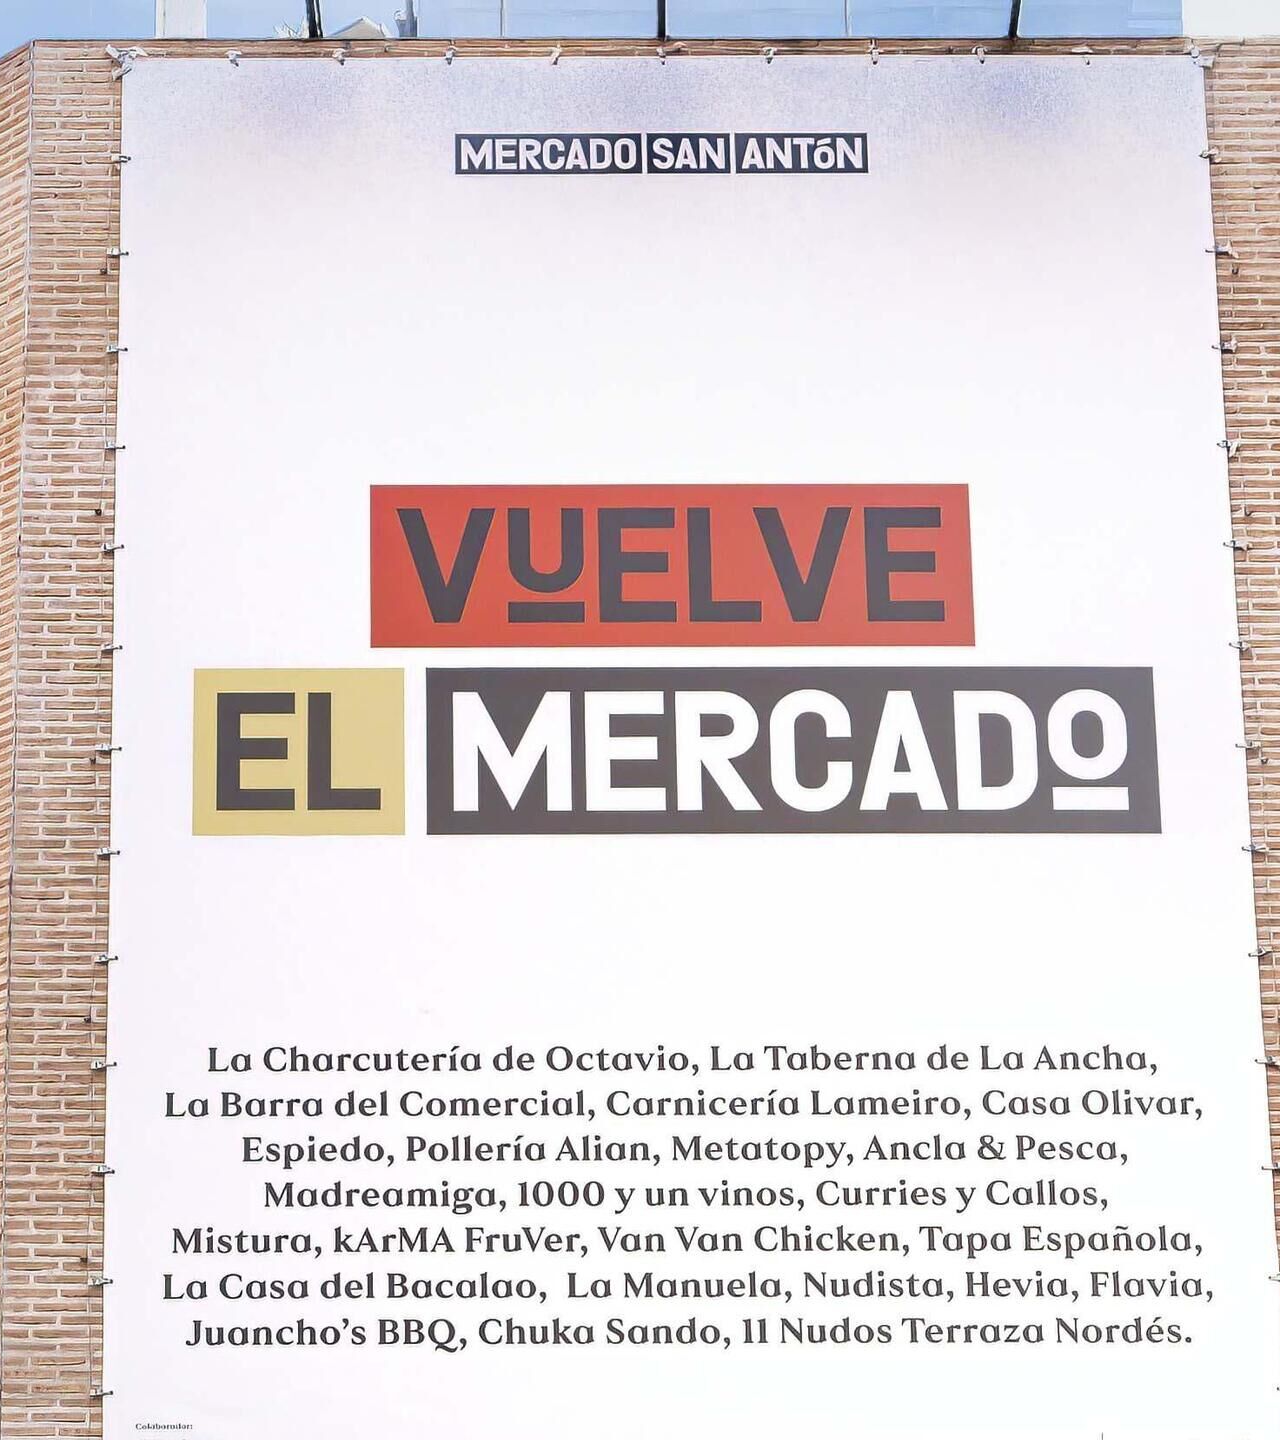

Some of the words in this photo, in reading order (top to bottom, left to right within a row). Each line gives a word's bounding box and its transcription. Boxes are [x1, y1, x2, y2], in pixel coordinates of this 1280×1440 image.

[459, 136, 638, 172] MERCADO
[651, 136, 727, 171] SAN
[215, 691, 382, 812] EL
[207, 1047, 252, 1073] La
[263, 1045, 482, 1072] Charcutería
[492, 1045, 535, 1072] de
[546, 1044, 699, 1076] Octavio,
[710, 1045, 755, 1071] La
[763, 1044, 916, 1071] Taberna
[926, 1044, 969, 1071] de
[980, 1045, 1024, 1071] La
[1033, 1044, 1157, 1076] Ancha,
[165, 1092, 209, 1118] La
[220, 1091, 323, 1117] Barra
[334, 1090, 389, 1117] del
[399, 1089, 596, 1122] Comercial,
[606, 1089, 800, 1116] Carnicería
[810, 1089, 971, 1121] Lameiro,
[982, 1089, 1071, 1116] Casa
[1081, 1089, 1202, 1121] Olivar,
[242, 1135, 395, 1170] Espiedo,
[406, 1135, 546, 1162] Pollería
[555, 1134, 661, 1167] Alian,
[672, 1135, 854, 1169] Metatopy,
[863, 1134, 966, 1161] Ancla
[977, 1134, 1007, 1161] &
[1015, 1135, 1128, 1166] Pesca,
[264, 1180, 507, 1215] Madreamiga,
[518, 1180, 605, 1207] 1000
[614, 1188, 636, 1215] y
[645, 1187, 689, 1207] un
[697, 1179, 805, 1212] vinos,
[816, 1179, 947, 1206] Curries
[955, 1187, 977, 1214] y
[986, 1179, 1108, 1211] Callos,
[172, 1226, 322, 1259] Mistura,
[333, 1226, 455, 1253] kArMA
[465, 1226, 588, 1258] FruVer,
[597, 1226, 666, 1253] Van
[674, 1226, 743, 1253] Van
[754, 1224, 910, 1257] Chicken,
[918, 1226, 1012, 1260] Tapa
[1022, 1225, 1202, 1260] Española,
[162, 1274, 208, 1300] La
[219, 1273, 309, 1300] Casa
[320, 1271, 375, 1300] del
[386, 1271, 547, 1304] Bacalao,
[567, 1272, 612, 1299] La
[623, 1271, 792, 1304] Manuela,
[803, 1270, 954, 1303] Nudista,
[965, 1270, 1079, 1303] Hevia,
[1090, 1270, 1213, 1303] Flavia,
[378, 1318, 467, 1353] BBQ,
[478, 1317, 595, 1345] Chuka
[606, 1316, 731, 1350] Sando,
[742, 1318, 769, 1344] 11
[780, 1316, 892, 1344] Nudos
[901, 1317, 1044, 1344] Terraza
[1055, 1316, 1192, 1344] Nordés.
